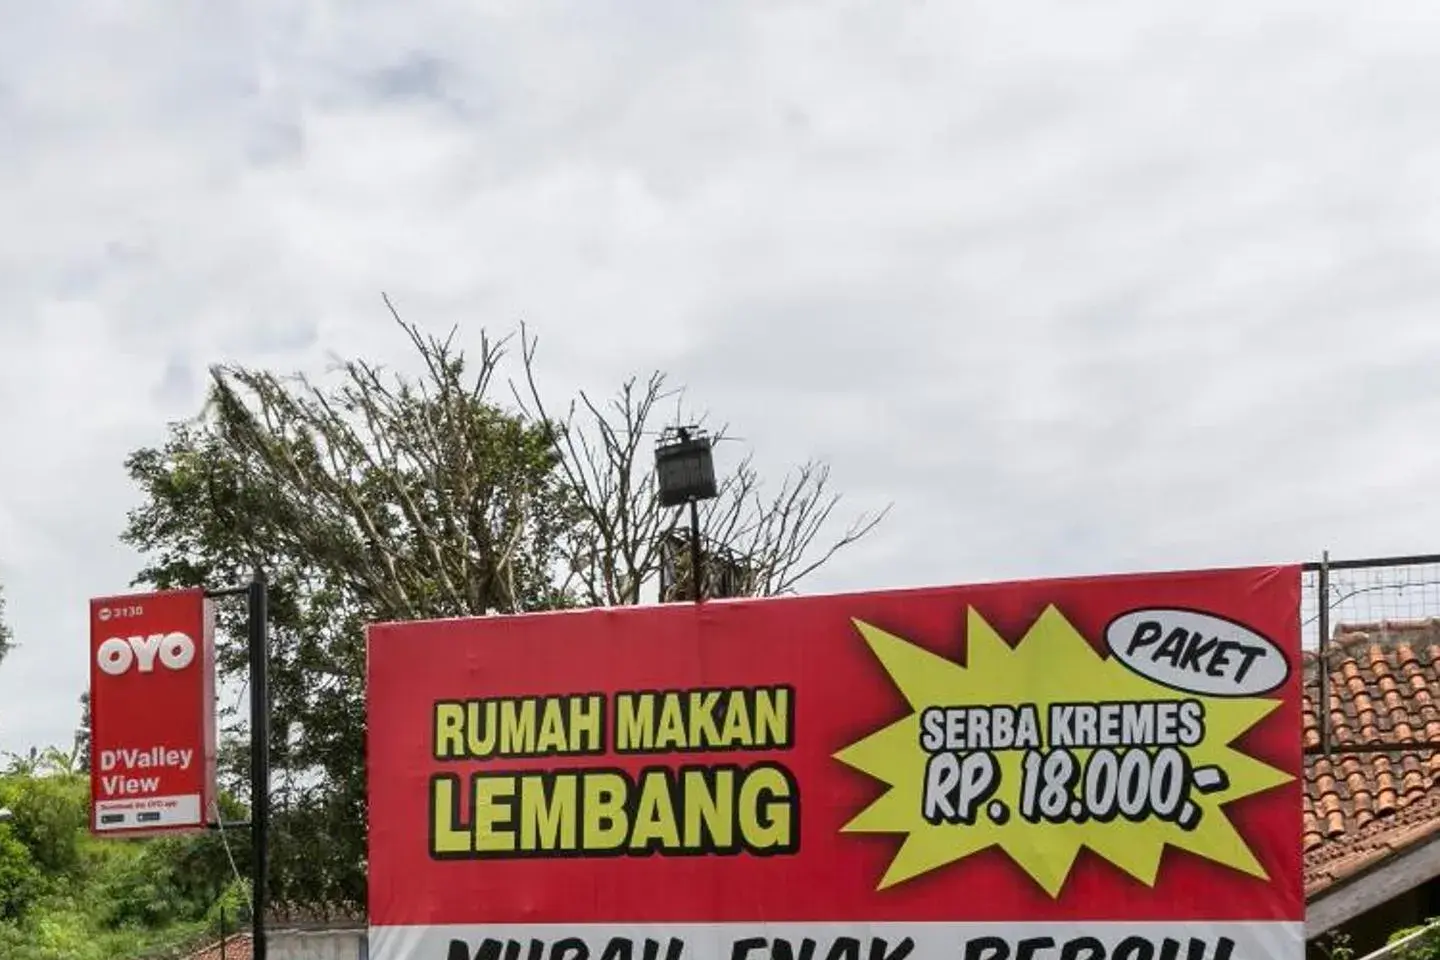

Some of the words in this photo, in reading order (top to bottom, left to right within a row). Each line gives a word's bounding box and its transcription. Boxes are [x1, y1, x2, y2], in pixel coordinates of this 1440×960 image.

[97, 632, 195, 675] OYO
[1126, 621, 1266, 684] PAKET
[434, 696, 602, 757] RUMAH
[616, 688, 790, 750] MAKAN
[921, 706, 1036, 750] SERBA
[1050, 702, 1204, 747] KREMES
[100, 747, 193, 771] D'Valley
[101, 775, 160, 796] View
[433, 766, 793, 853] LEMBANG
[924, 751, 1009, 823] RP.
